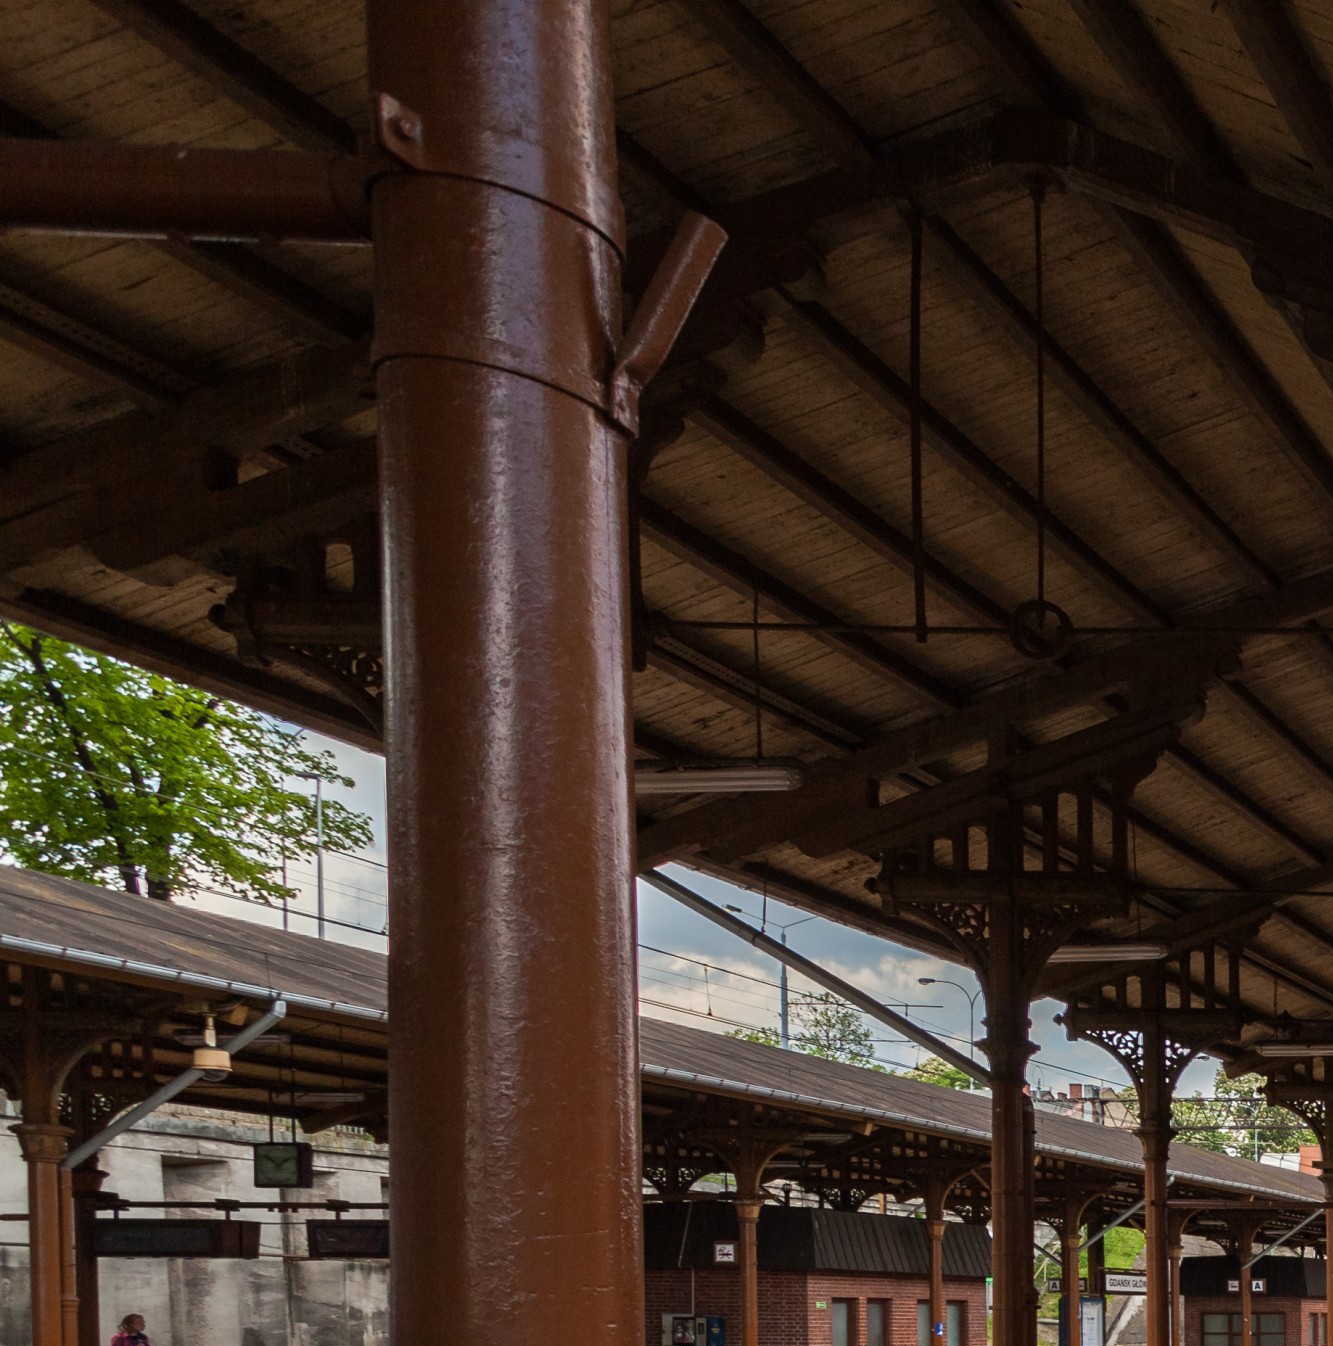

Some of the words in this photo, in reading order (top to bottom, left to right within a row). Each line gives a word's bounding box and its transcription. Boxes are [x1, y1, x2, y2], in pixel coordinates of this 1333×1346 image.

[1051, 1281, 1058, 1290] A
[1108, 1277, 1131, 1288] GDAŃSK
[1254, 1281, 1261, 1290] A
